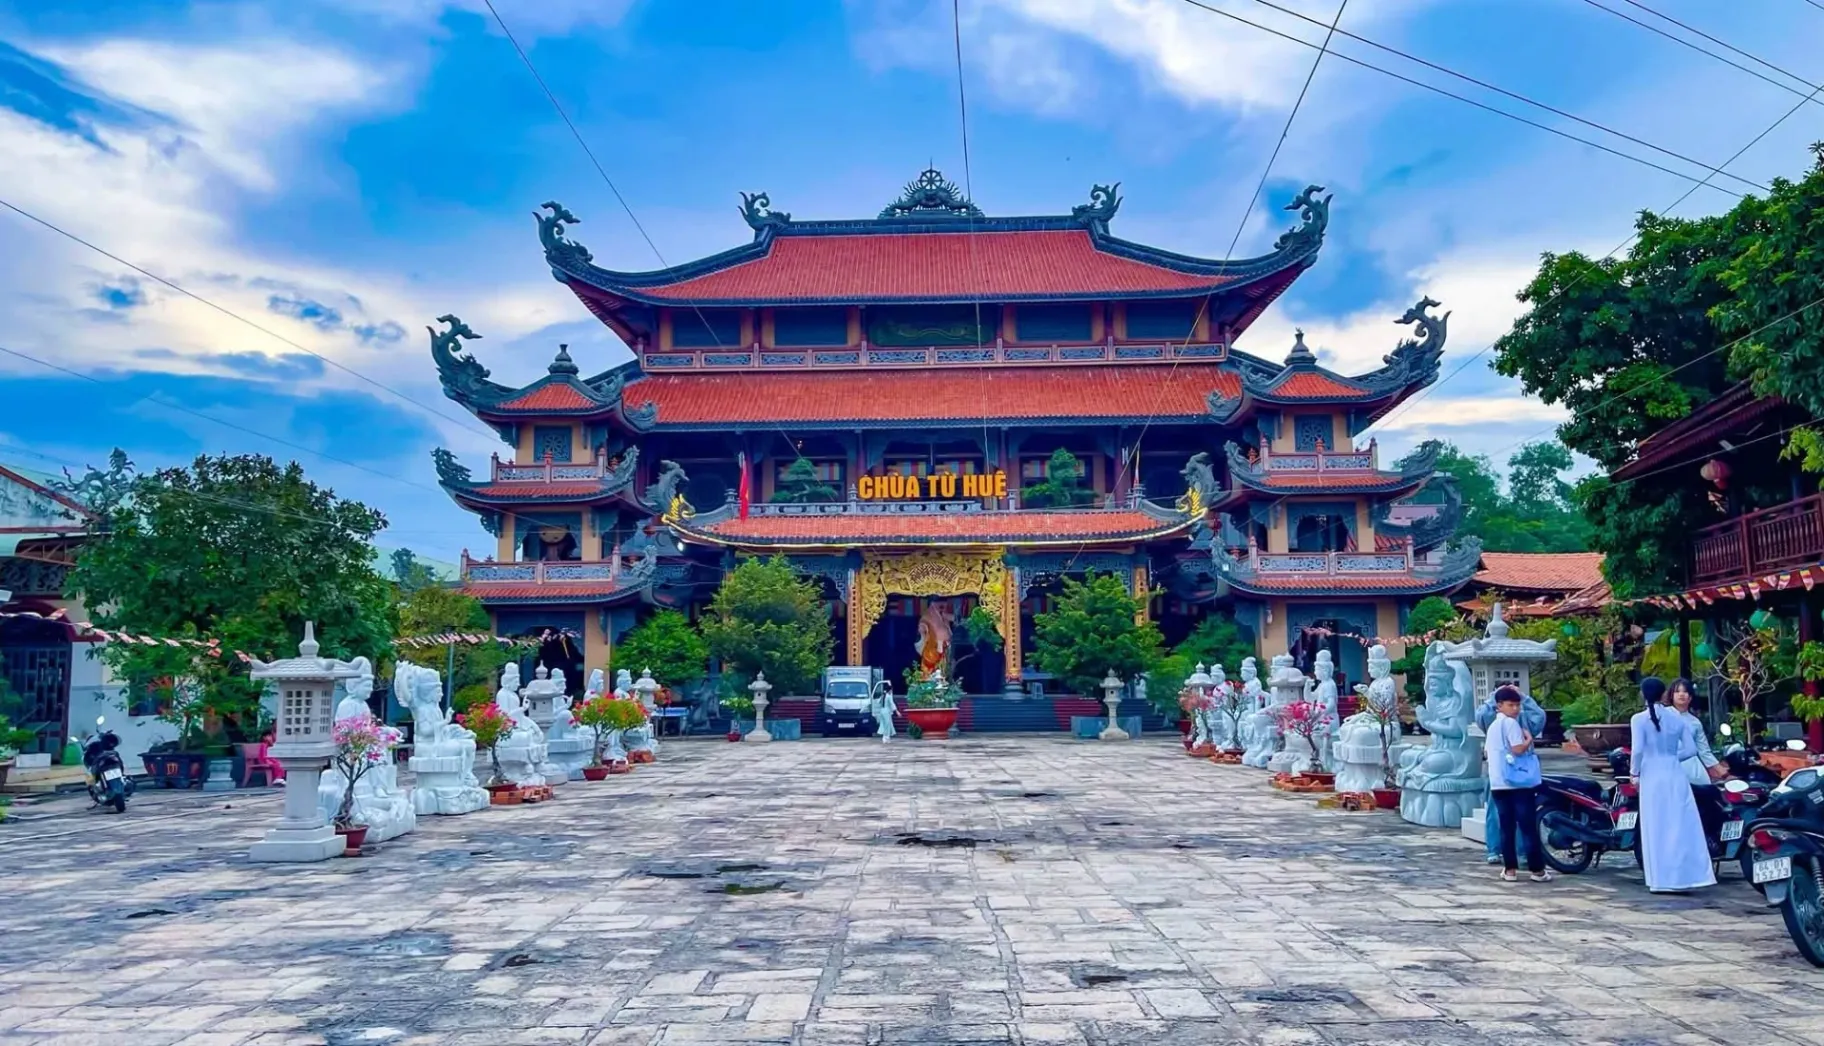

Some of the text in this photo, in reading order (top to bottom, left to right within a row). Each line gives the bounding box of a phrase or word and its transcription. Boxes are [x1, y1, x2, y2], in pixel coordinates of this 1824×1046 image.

[858, 469, 1007, 500] CHÙA TỪ HUỆ
